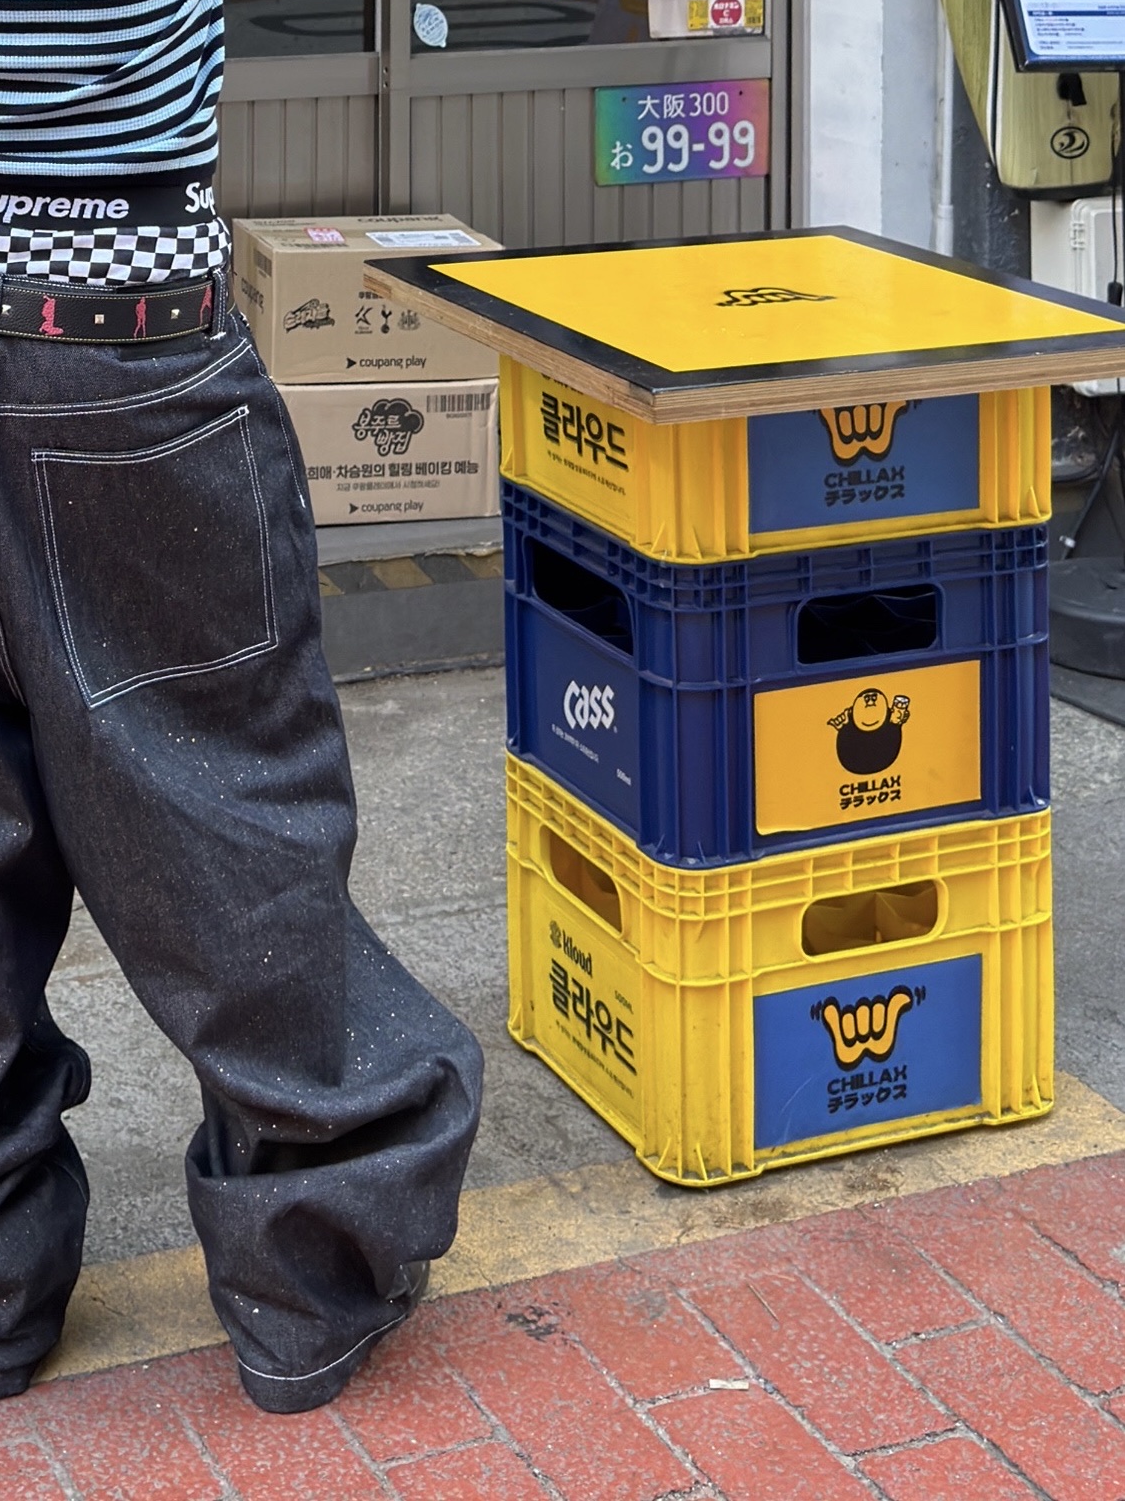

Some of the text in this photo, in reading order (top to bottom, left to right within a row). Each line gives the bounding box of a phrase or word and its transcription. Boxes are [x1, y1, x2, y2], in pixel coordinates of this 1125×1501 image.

[637, 92, 729, 119] 大阪 300
[610, 120, 755, 174] お 99-99
[359, 356, 427, 371] coupang play
[356, 412, 402, 440] 봉주르
[540, 391, 629, 473] 클라우드
[376, 430, 412, 454] 빵집
[306, 459, 478, 481] 희애·차승원의 힐링 베이킹 예능
[825, 467, 905, 486] CHILLAX
[825, 484, 905, 506] チラックス
[361, 501, 424, 515] coupang play
[564, 680, 615, 730] Cass
[839, 775, 901, 796] CHILLAX
[840, 789, 901, 810] チラックス
[549, 957, 638, 1076] 클라우드
[827, 1064, 907, 1094] CHILLAX
[828, 1084, 907, 1113] チラックス
